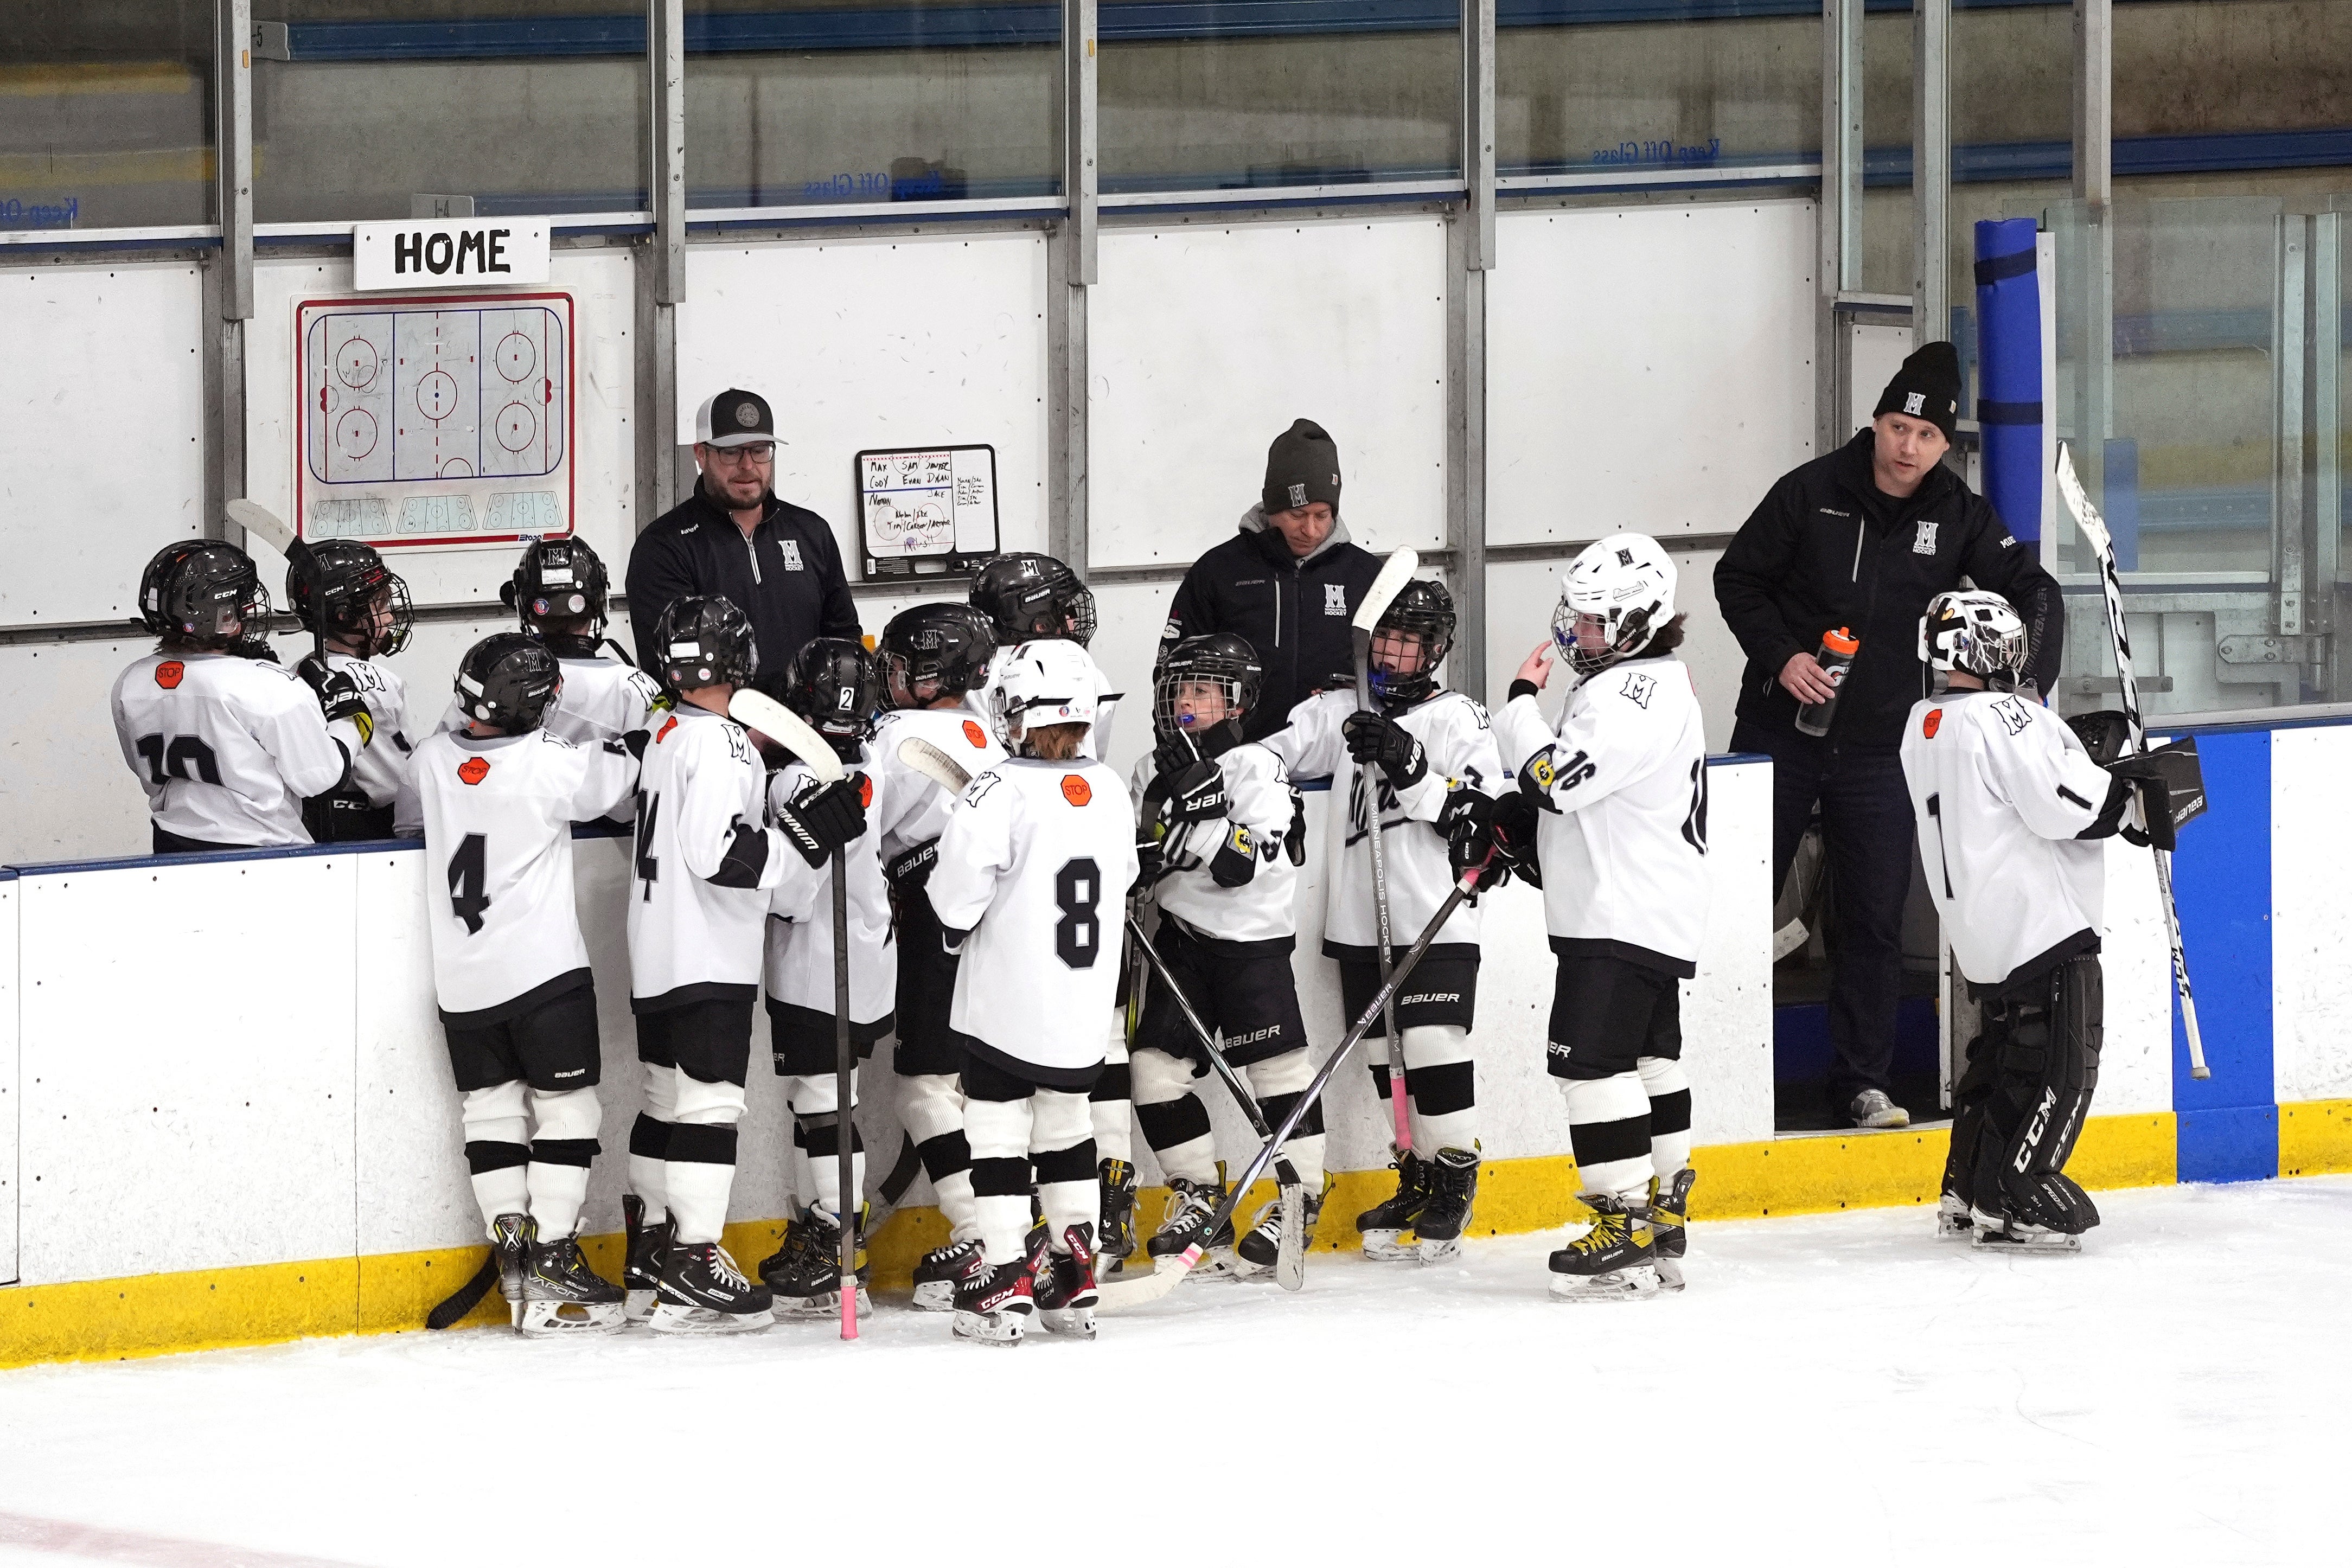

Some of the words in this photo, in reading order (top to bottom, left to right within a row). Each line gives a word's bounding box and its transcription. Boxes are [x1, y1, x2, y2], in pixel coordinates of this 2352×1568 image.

[395, 229, 511, 274] HOME
[871, 462, 887, 472] MAX
[902, 460, 918, 472] SAM
[870, 476, 889, 488] CODY
[903, 475, 921, 485] EVAN
[214, 589, 238, 600] CCM
[325, 585, 344, 596] CCM
[1954, 632, 1964, 650] 1
[158, 668, 181, 678] STOP
[841, 689, 852, 708] 2
[462, 766, 487, 775] STOP
[1065, 784, 1088, 796] STOP
[1185, 791, 1226, 811] UER
[1926, 792, 1955, 900] 1
[448, 831, 491, 937] 4
[1370, 803, 1387, 901] MINNEAPOLIS
[1379, 904, 1392, 964] HOCKEY
[1054, 855, 1103, 971] 8
[1364, 983, 1394, 1020] BAUER
[1401, 993, 1460, 1006] BAUER
[1225, 1025, 1281, 1048] BAUER
[554, 1068, 586, 1078] BAUER
[2013, 1086, 2057, 1174] CCM
[1067, 1234, 1089, 1259] CCM
[528, 1271, 579, 1302] VAPOR
[980, 1288, 1015, 1309] CCM
